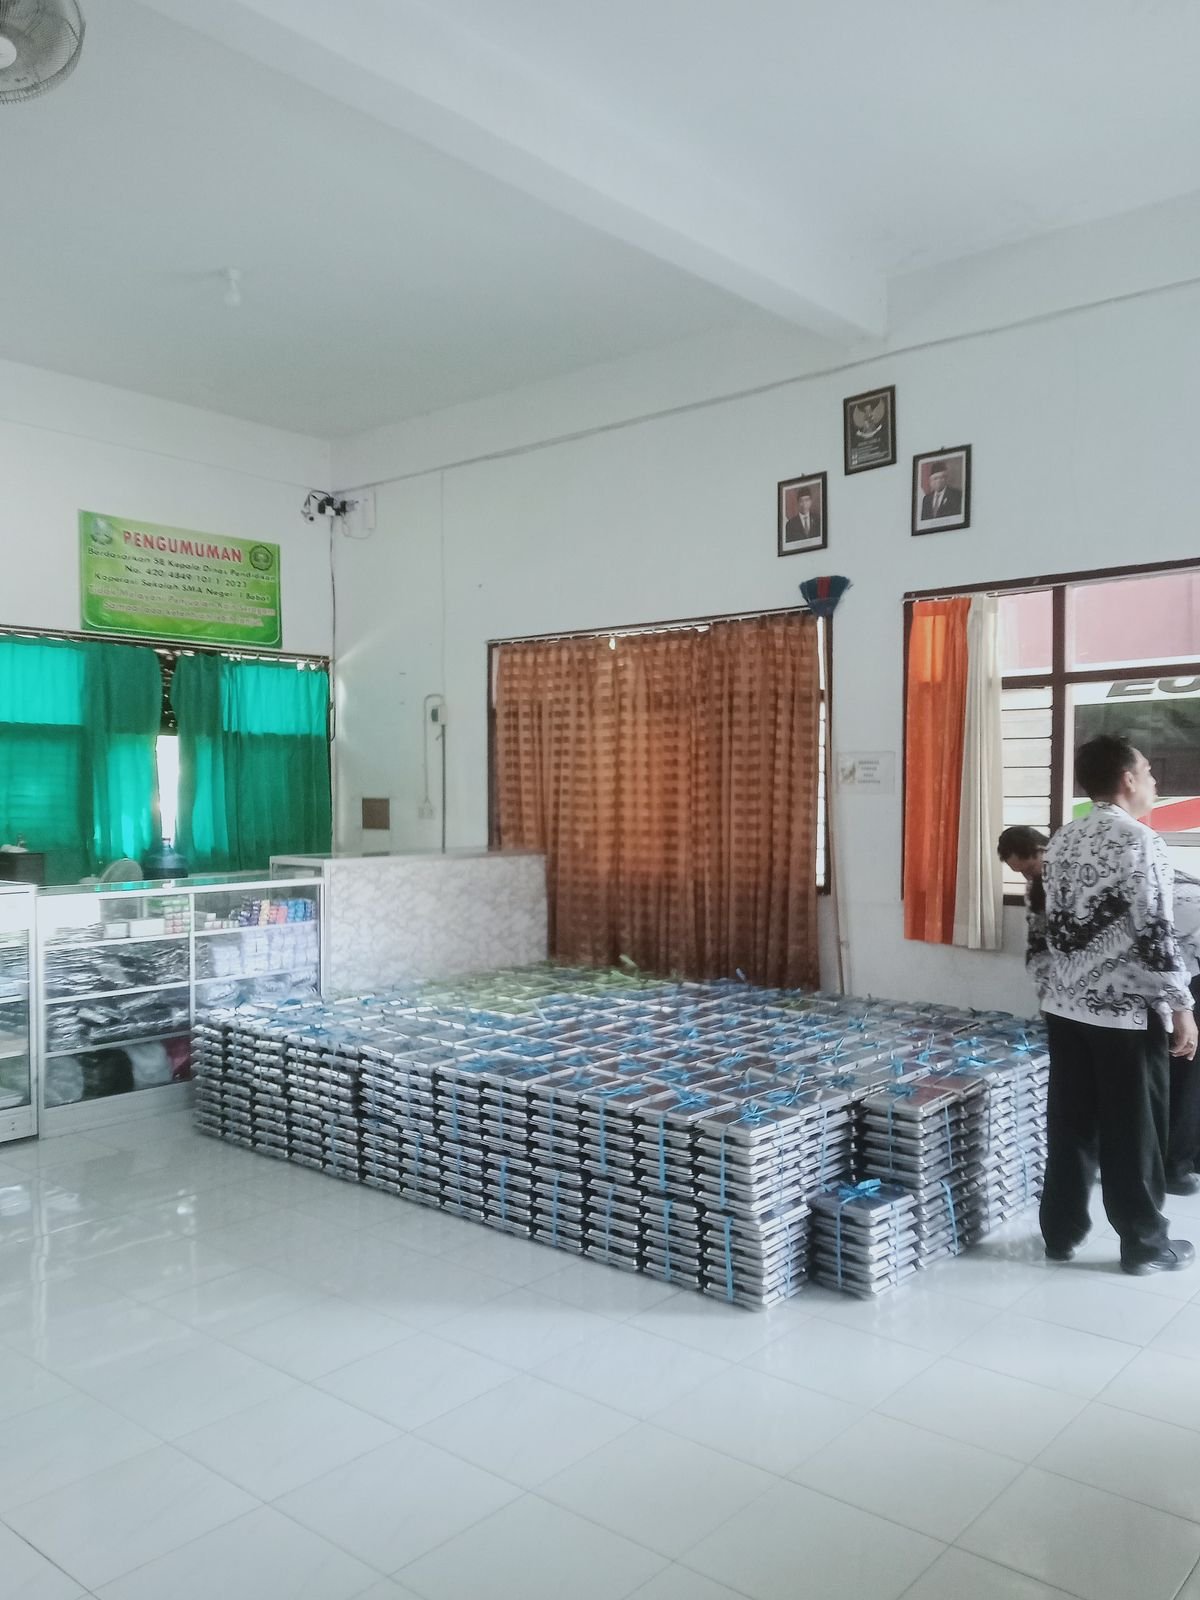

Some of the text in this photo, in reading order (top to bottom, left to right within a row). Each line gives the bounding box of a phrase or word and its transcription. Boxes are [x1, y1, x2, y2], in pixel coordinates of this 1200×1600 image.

[123, 530, 242, 563] PENGUMUMAN
[88, 546, 276, 581] Berdasarkan SE Kepala Dinas Pendidikan
[95, 572, 137, 585] Koperasi
[142, 579, 179, 590] Sekolah
[181, 584, 203, 594] SMA
[206, 588, 233, 598] Negeri
